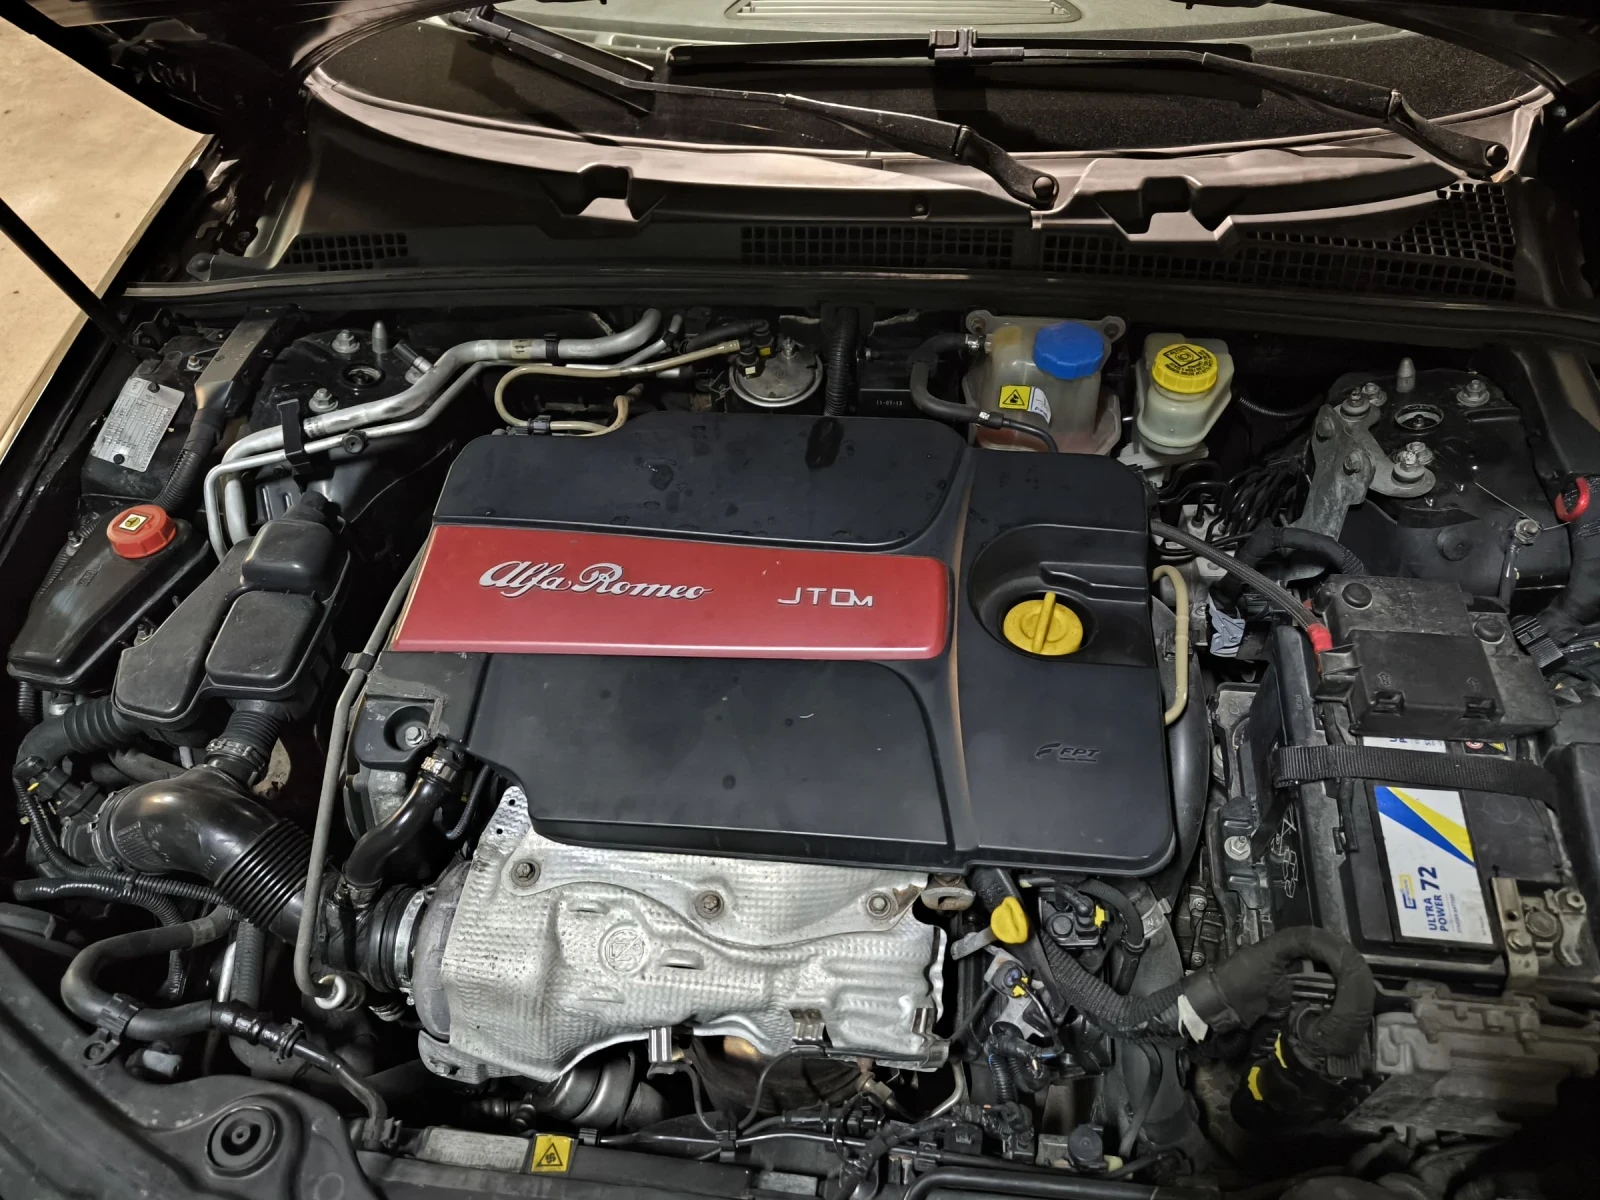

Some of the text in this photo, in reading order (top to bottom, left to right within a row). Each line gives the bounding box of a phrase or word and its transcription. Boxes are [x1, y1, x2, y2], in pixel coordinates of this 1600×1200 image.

[479, 560, 713, 600] Alfa Romeo
[1417, 866, 1441, 931] ULTRA 72
[1433, 894, 1449, 932] POWER
